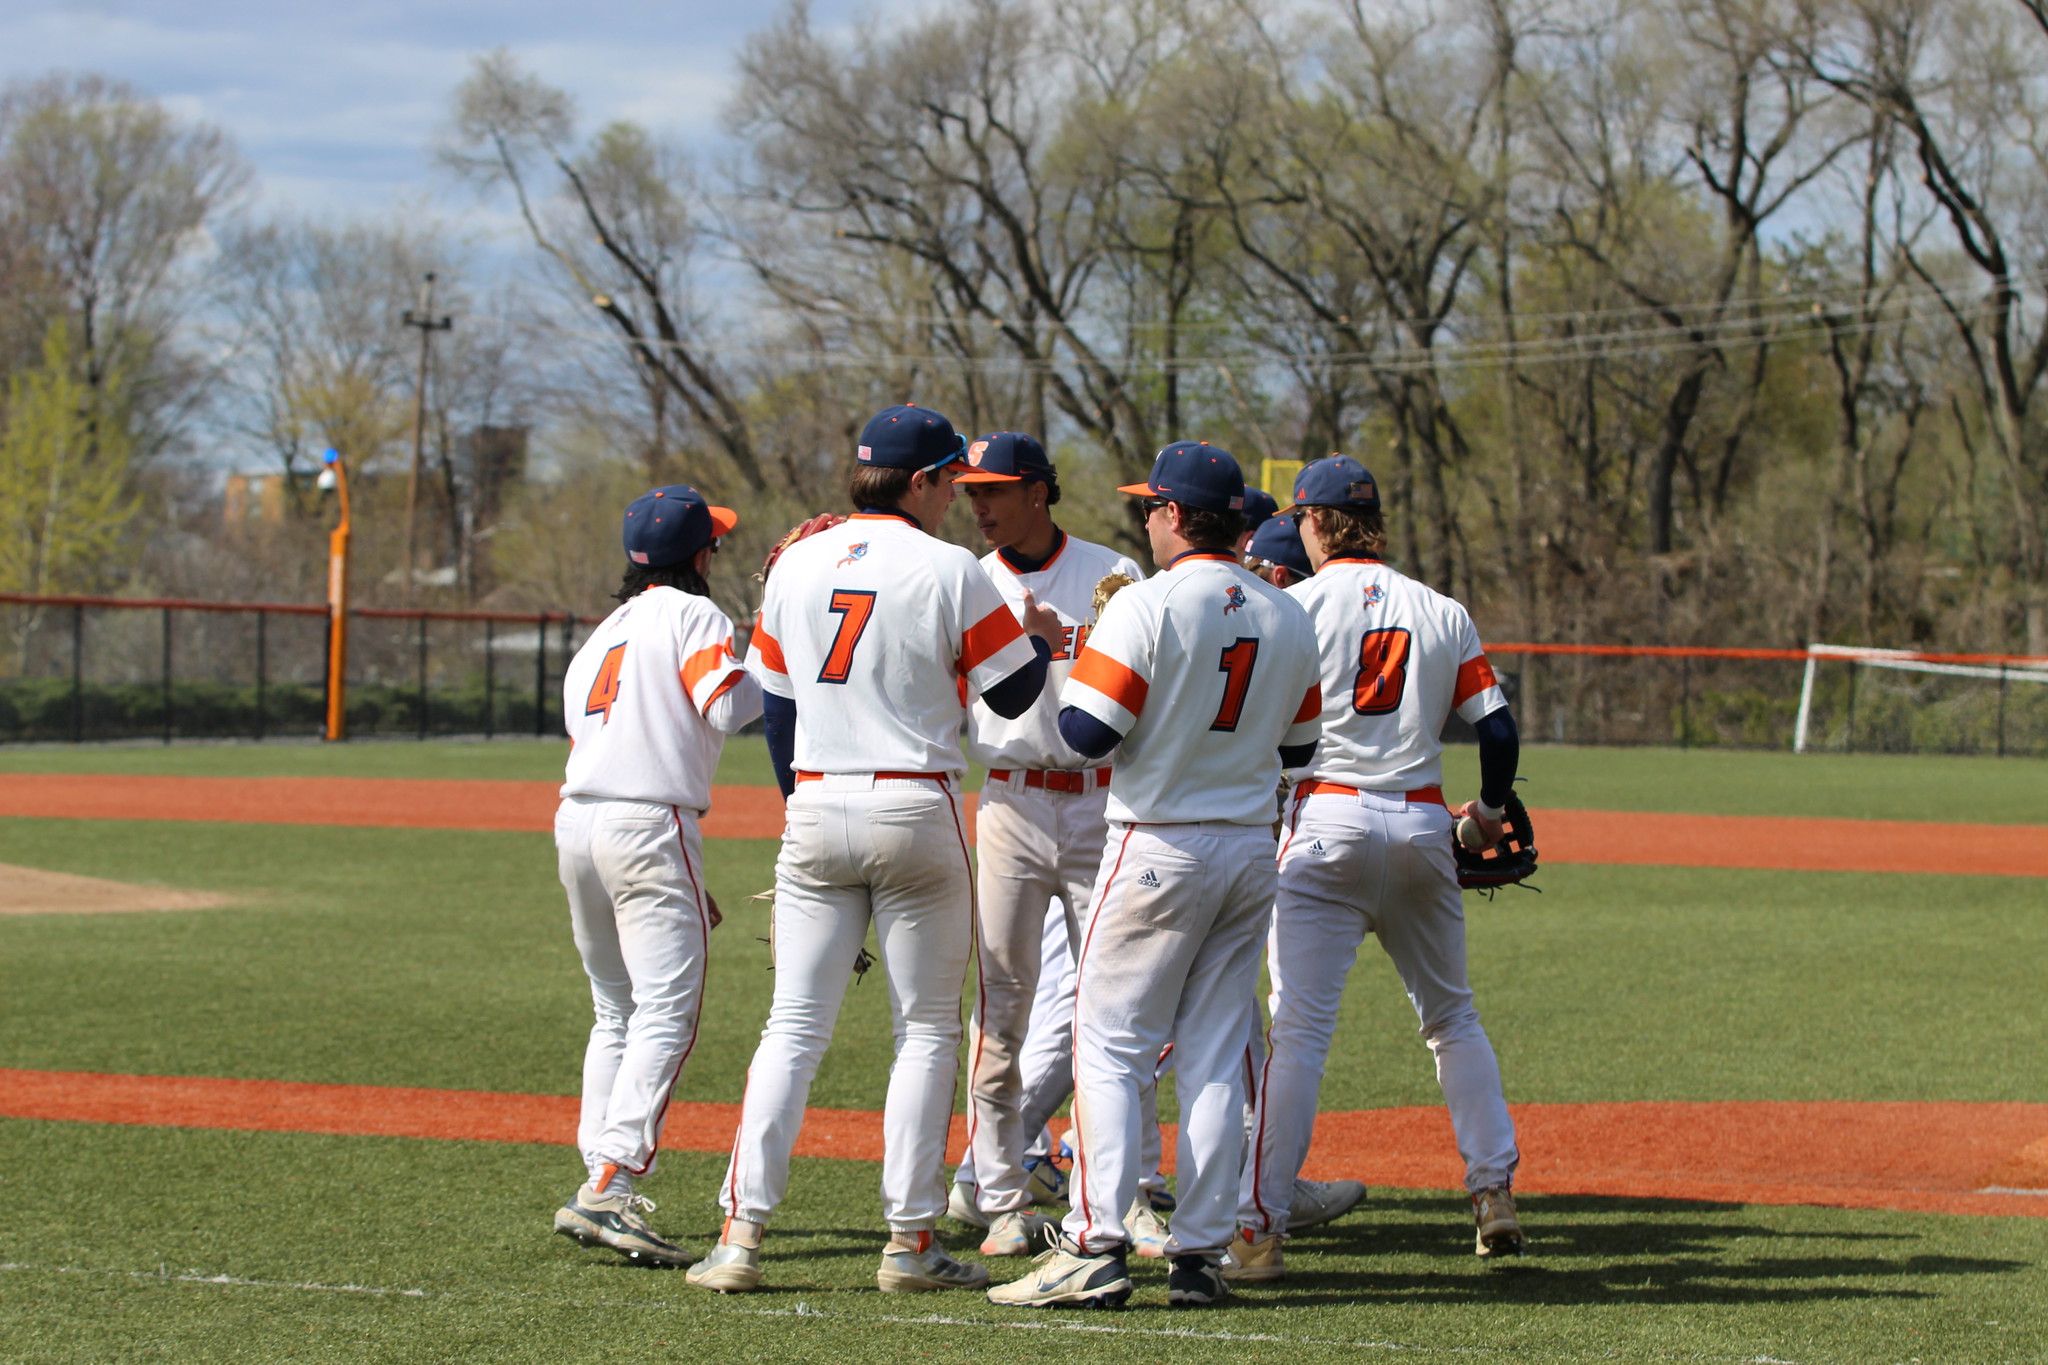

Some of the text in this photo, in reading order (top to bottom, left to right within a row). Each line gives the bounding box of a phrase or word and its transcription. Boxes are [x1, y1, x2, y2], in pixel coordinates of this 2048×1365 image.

[967, 440, 989, 467] S
[816, 588, 877, 684] 7
[1352, 627, 1411, 716] 8
[585, 639, 628, 730] 4
[1209, 636, 1260, 733] 1
